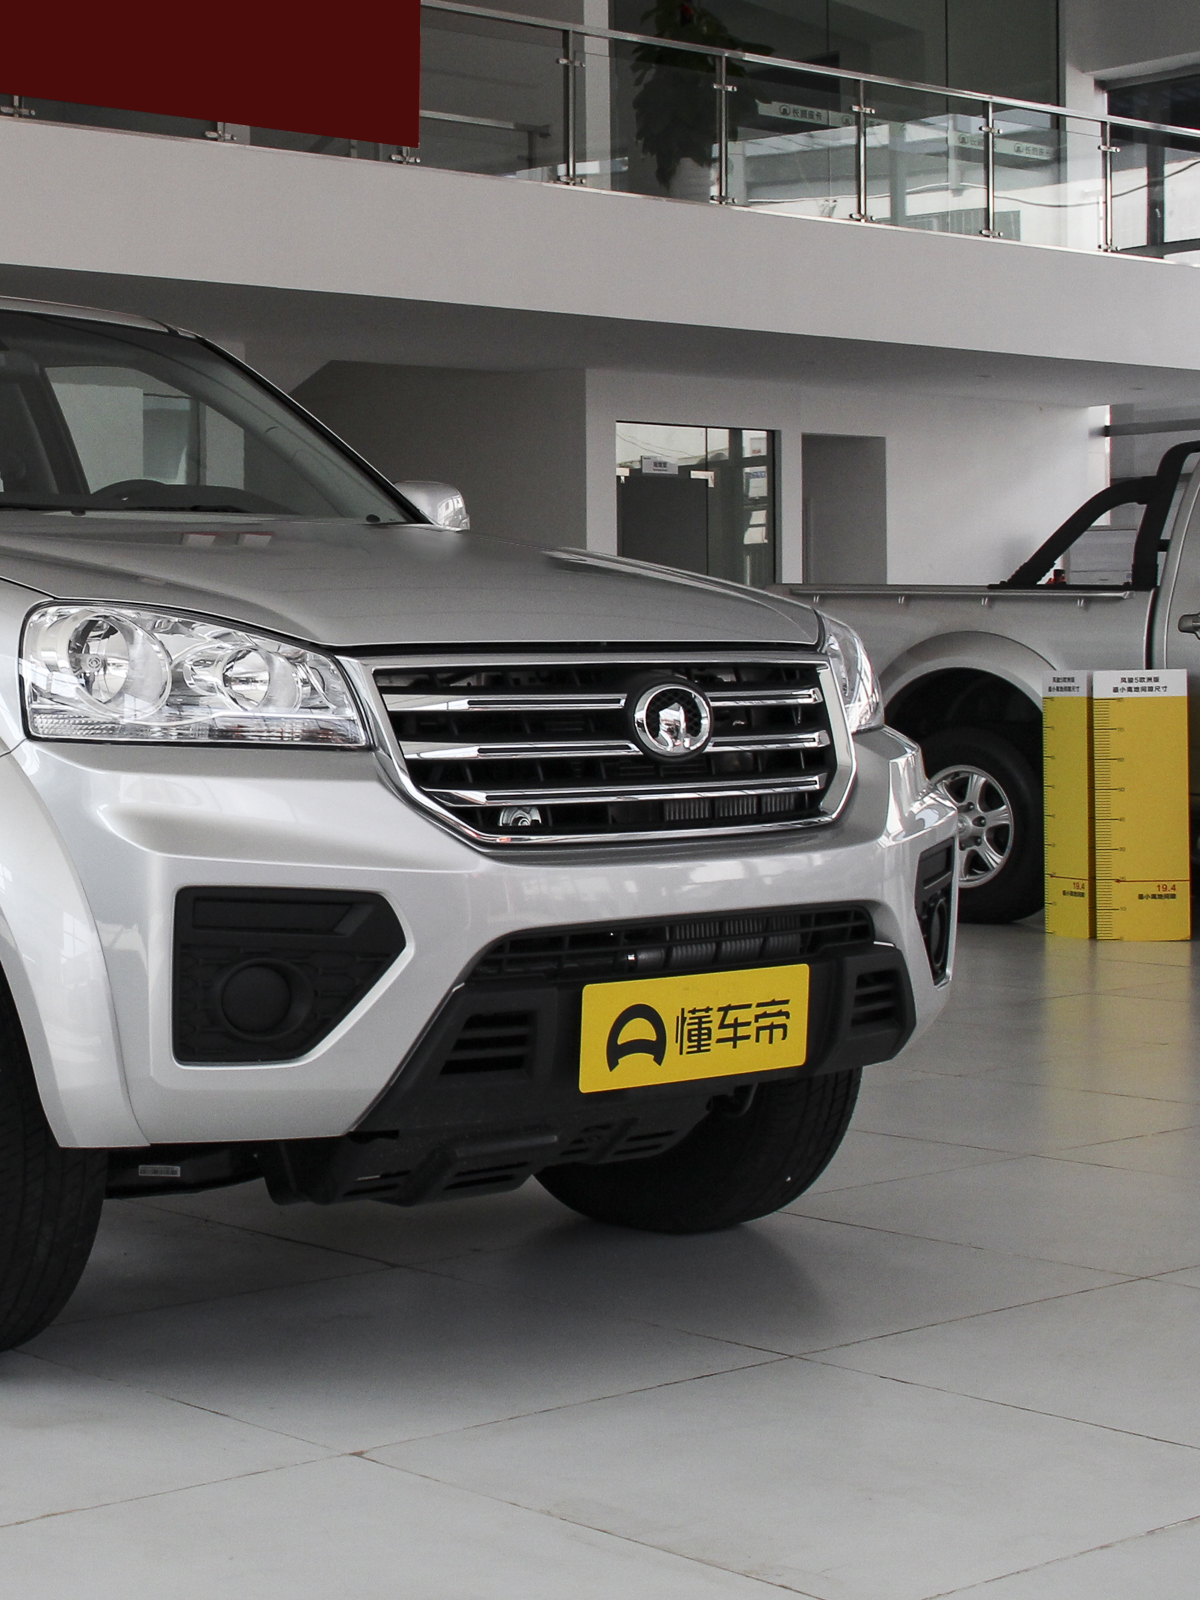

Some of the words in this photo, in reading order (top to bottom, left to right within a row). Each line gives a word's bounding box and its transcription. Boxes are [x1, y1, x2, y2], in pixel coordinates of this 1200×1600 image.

[1072, 882, 1085, 890] 19.4
[1156, 883, 1177, 892] 19.4
[675, 999, 791, 1056] 懂车帝
